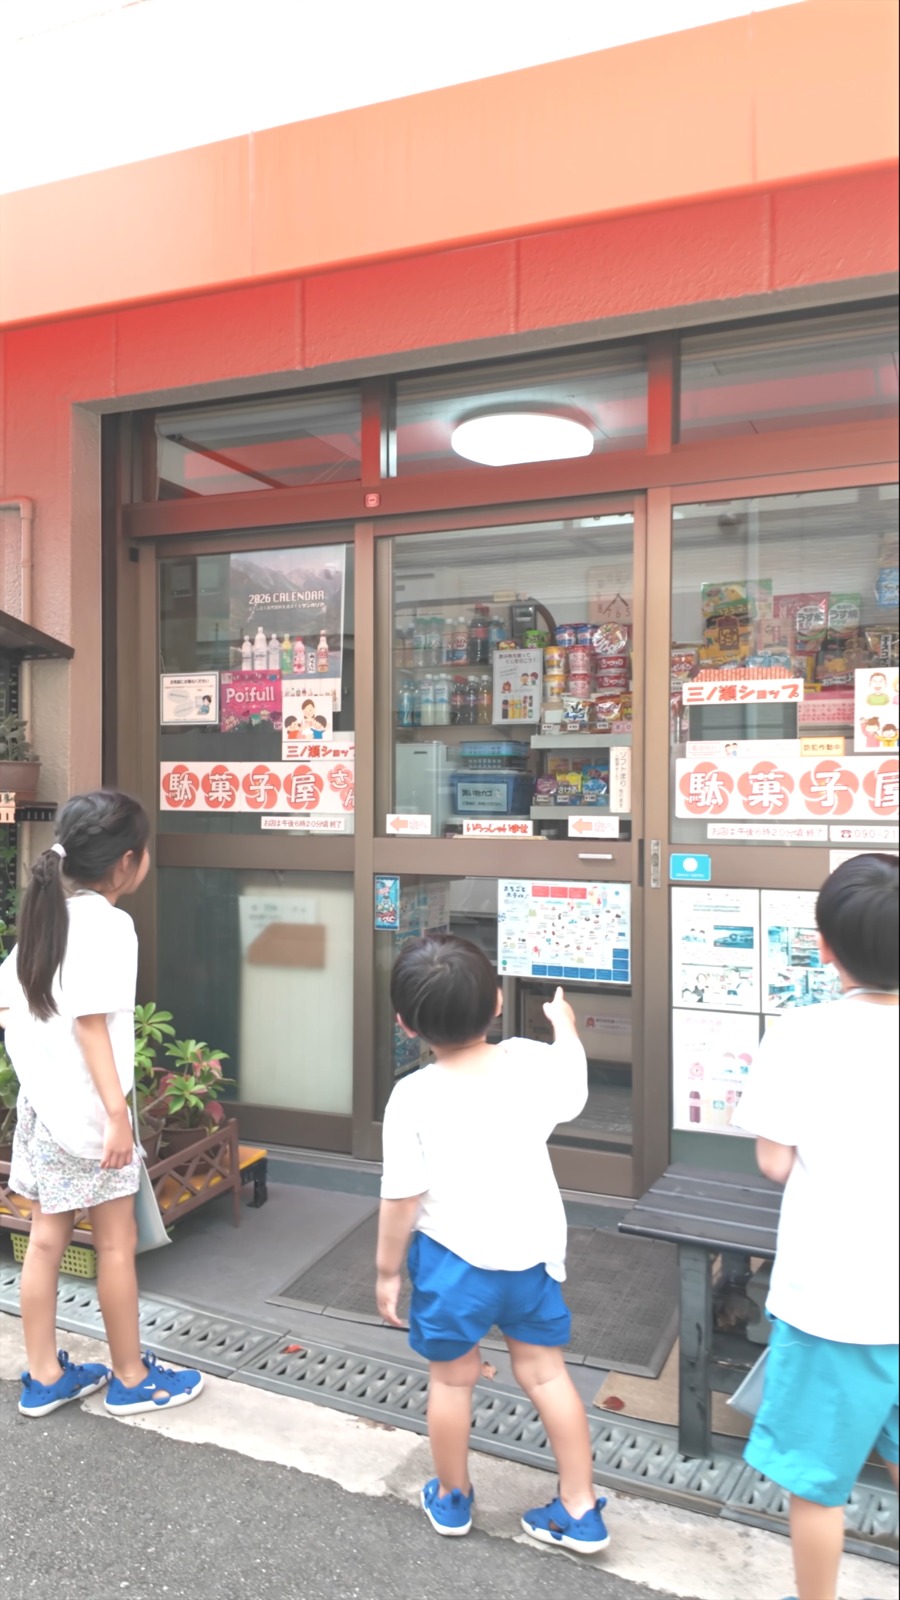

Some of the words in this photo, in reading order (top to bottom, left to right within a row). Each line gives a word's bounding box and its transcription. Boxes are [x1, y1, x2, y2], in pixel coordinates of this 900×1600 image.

[248, 593, 271, 605] 2026
[272, 590, 325, 603] CALENDAR
[226, 686, 275, 703] Poifull
[686, 683, 800, 702] 三ノ瀬ショップ
[462, 789, 493, 797] 買い物カゴ
[688, 771, 899, 808] 駄菓子屋
